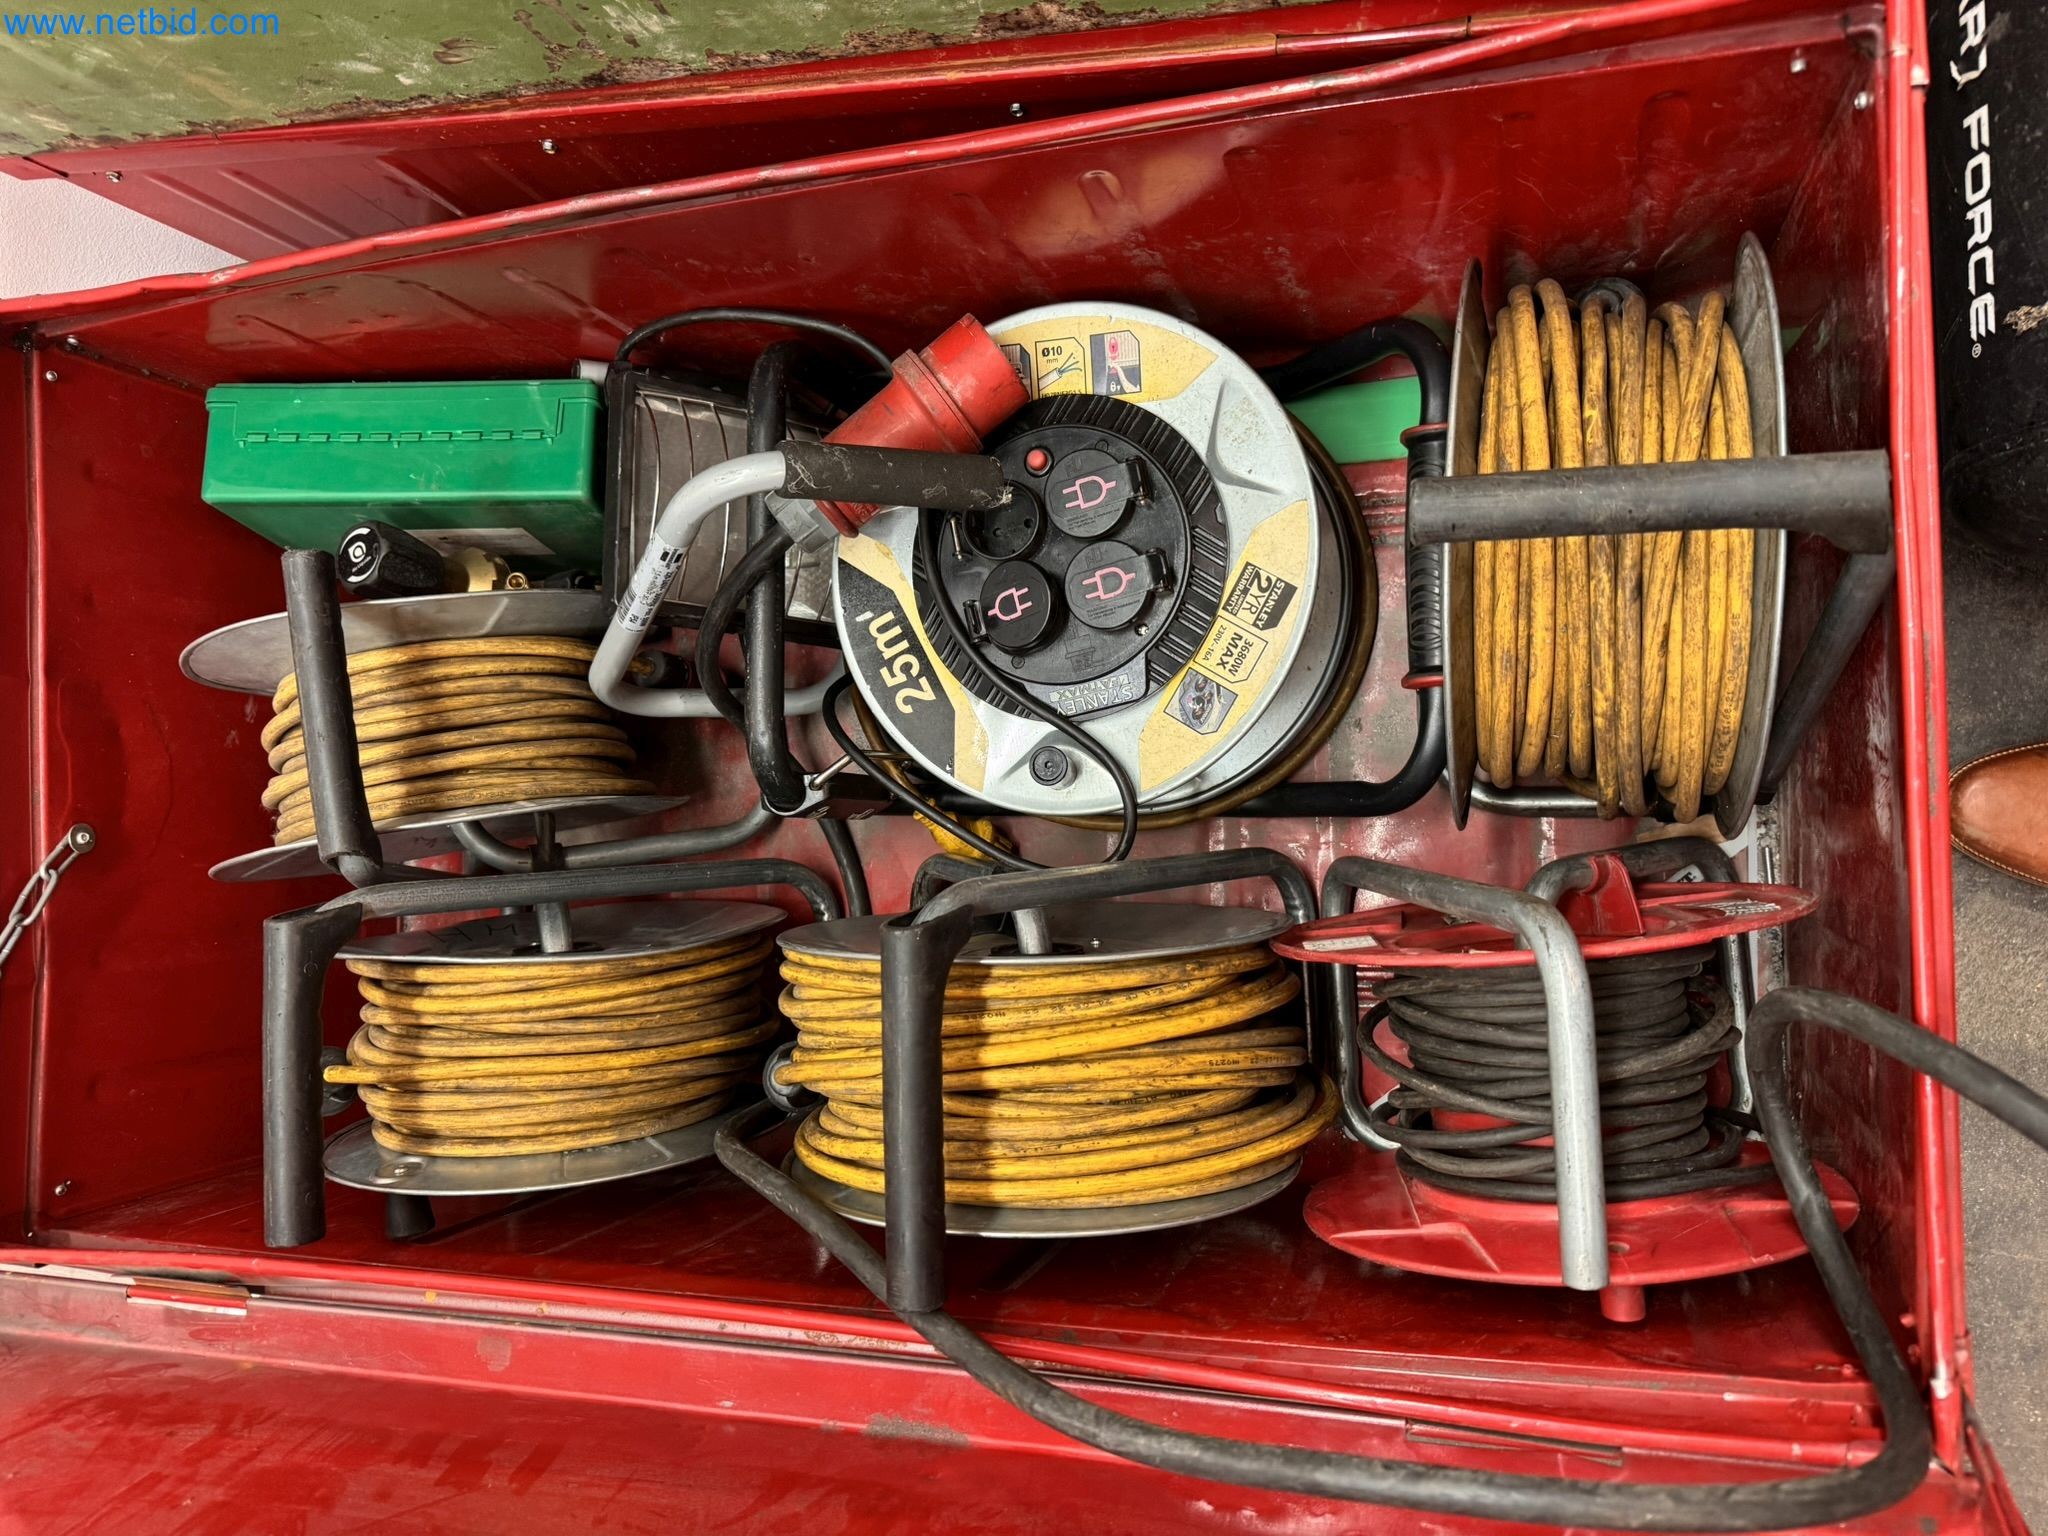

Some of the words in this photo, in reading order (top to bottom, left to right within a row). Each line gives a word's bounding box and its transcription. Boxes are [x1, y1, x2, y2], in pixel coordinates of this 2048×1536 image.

[1226, 565, 1255, 612] WARRANTY
[1256, 580, 1285, 629] STANLEY
[1216, 632, 1243, 670] MAX
[1228, 638, 1254, 677] 3680W
[1056, 685, 1133, 716] STANLEY
